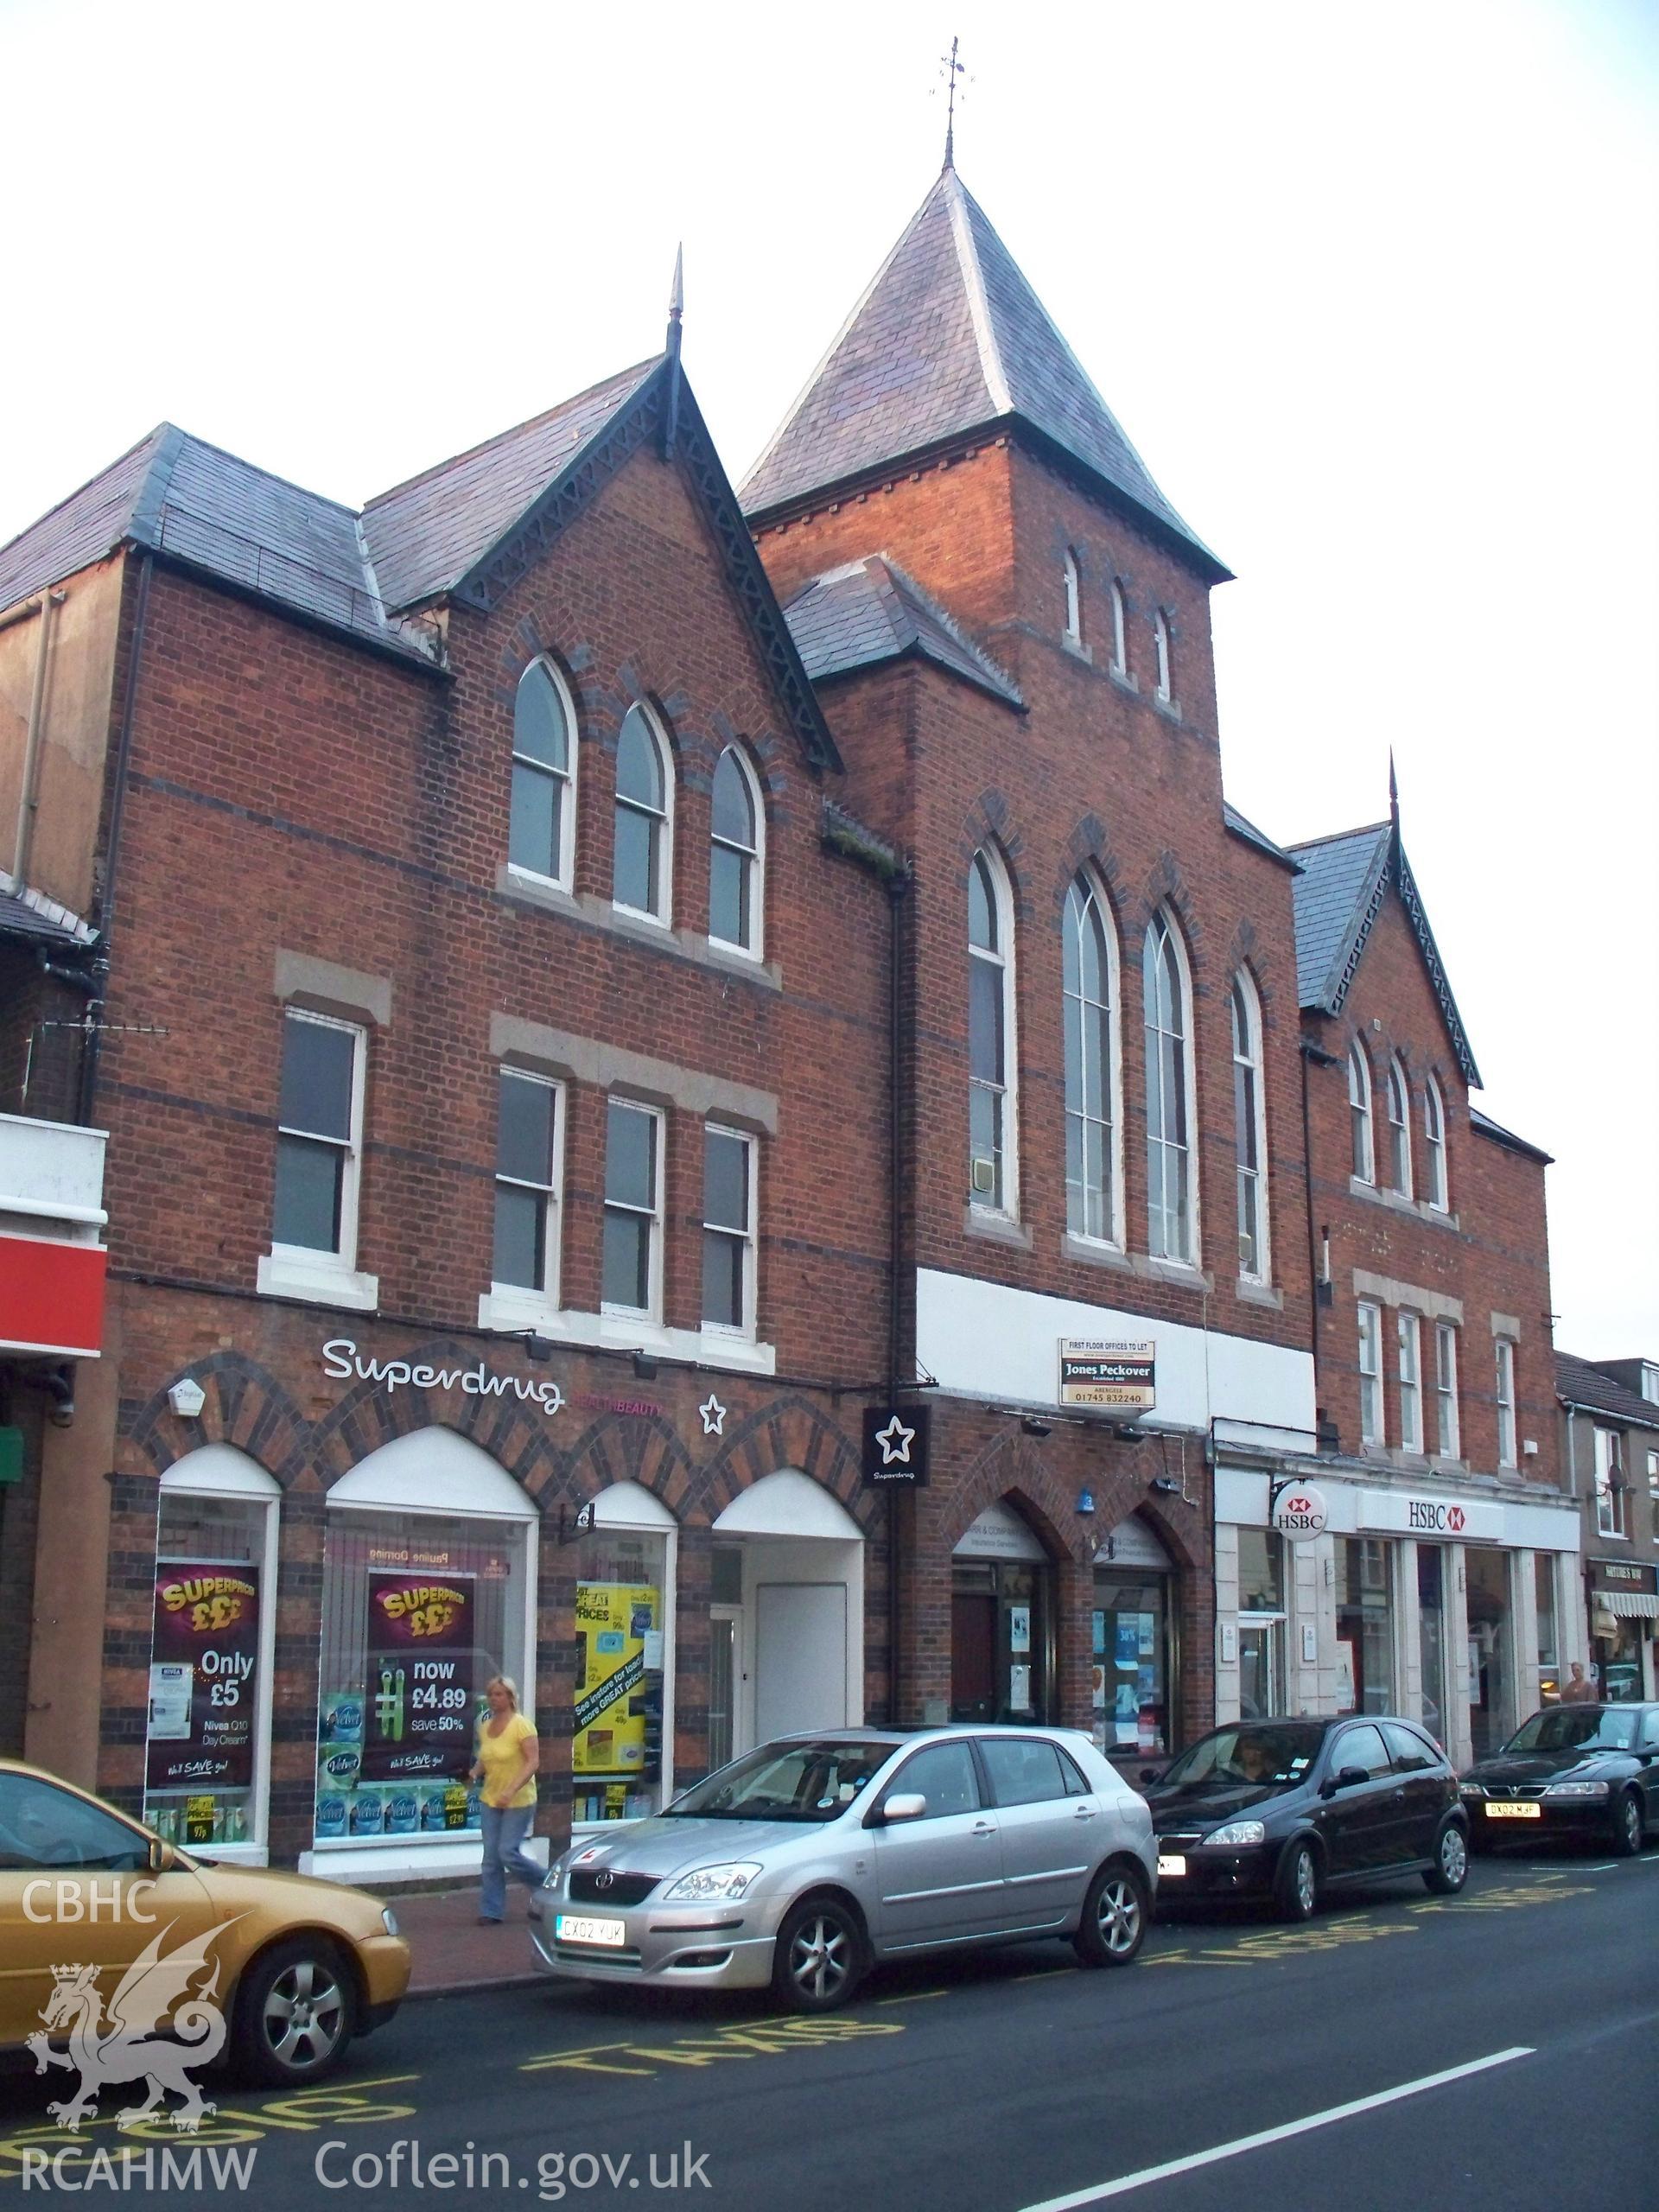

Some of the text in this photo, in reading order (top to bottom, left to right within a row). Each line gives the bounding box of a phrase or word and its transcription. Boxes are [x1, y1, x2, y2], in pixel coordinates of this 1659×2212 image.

[322, 1339, 565, 1414] Superdrug
[1066, 1363, 1150, 1376] Jones Peckover
[874, 1471, 915, 1480] Superdrug
[1279, 1515, 1323, 1529] HSBC
[1409, 1502, 1445, 1530] HSBC
[192, 1596, 241, 1631] £££
[411, 1603, 453, 1637] £££
[201, 1650, 253, 1681] Only
[414, 1662, 454, 1679] now
[211, 1680, 239, 1707] £5
[412, 1684, 466, 1709] £4.89
[575, 1701, 590, 1715] See
[590, 1681, 613, 1704] instore
[614, 1670, 625, 1683] for
[581, 1707, 599, 1726] more
[599, 1684, 624, 1708] GREAT
[204, 1721, 229, 1731] Nivea
[411, 1719, 437, 1732] save
[438, 1716, 464, 1731] 50%
[203, 1735, 219, 1746] Day
[184, 1759, 213, 1773] SAVE
[328, 1757, 358, 1771] Velvet
[405, 1753, 430, 1766] SAVE
[564, 1921, 620, 1940] CX02 YUK
[519, 2018, 906, 2075] TAXIS
